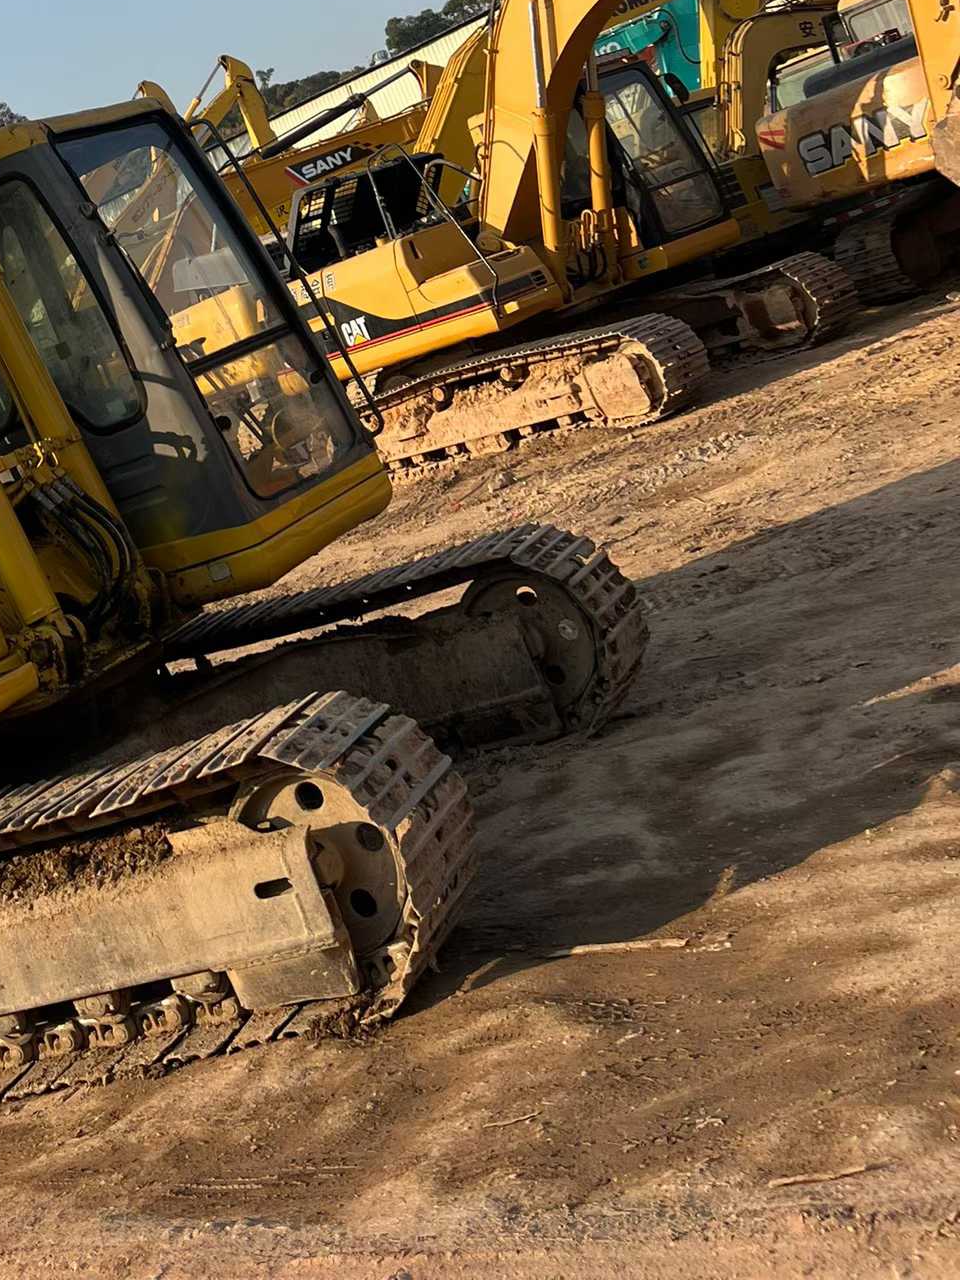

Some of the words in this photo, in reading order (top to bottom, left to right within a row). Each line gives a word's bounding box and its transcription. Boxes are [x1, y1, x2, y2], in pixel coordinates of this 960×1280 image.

[797, 97, 930, 177] SANY
[301, 147, 353, 179] SANY
[340, 317, 371, 347] CAT
